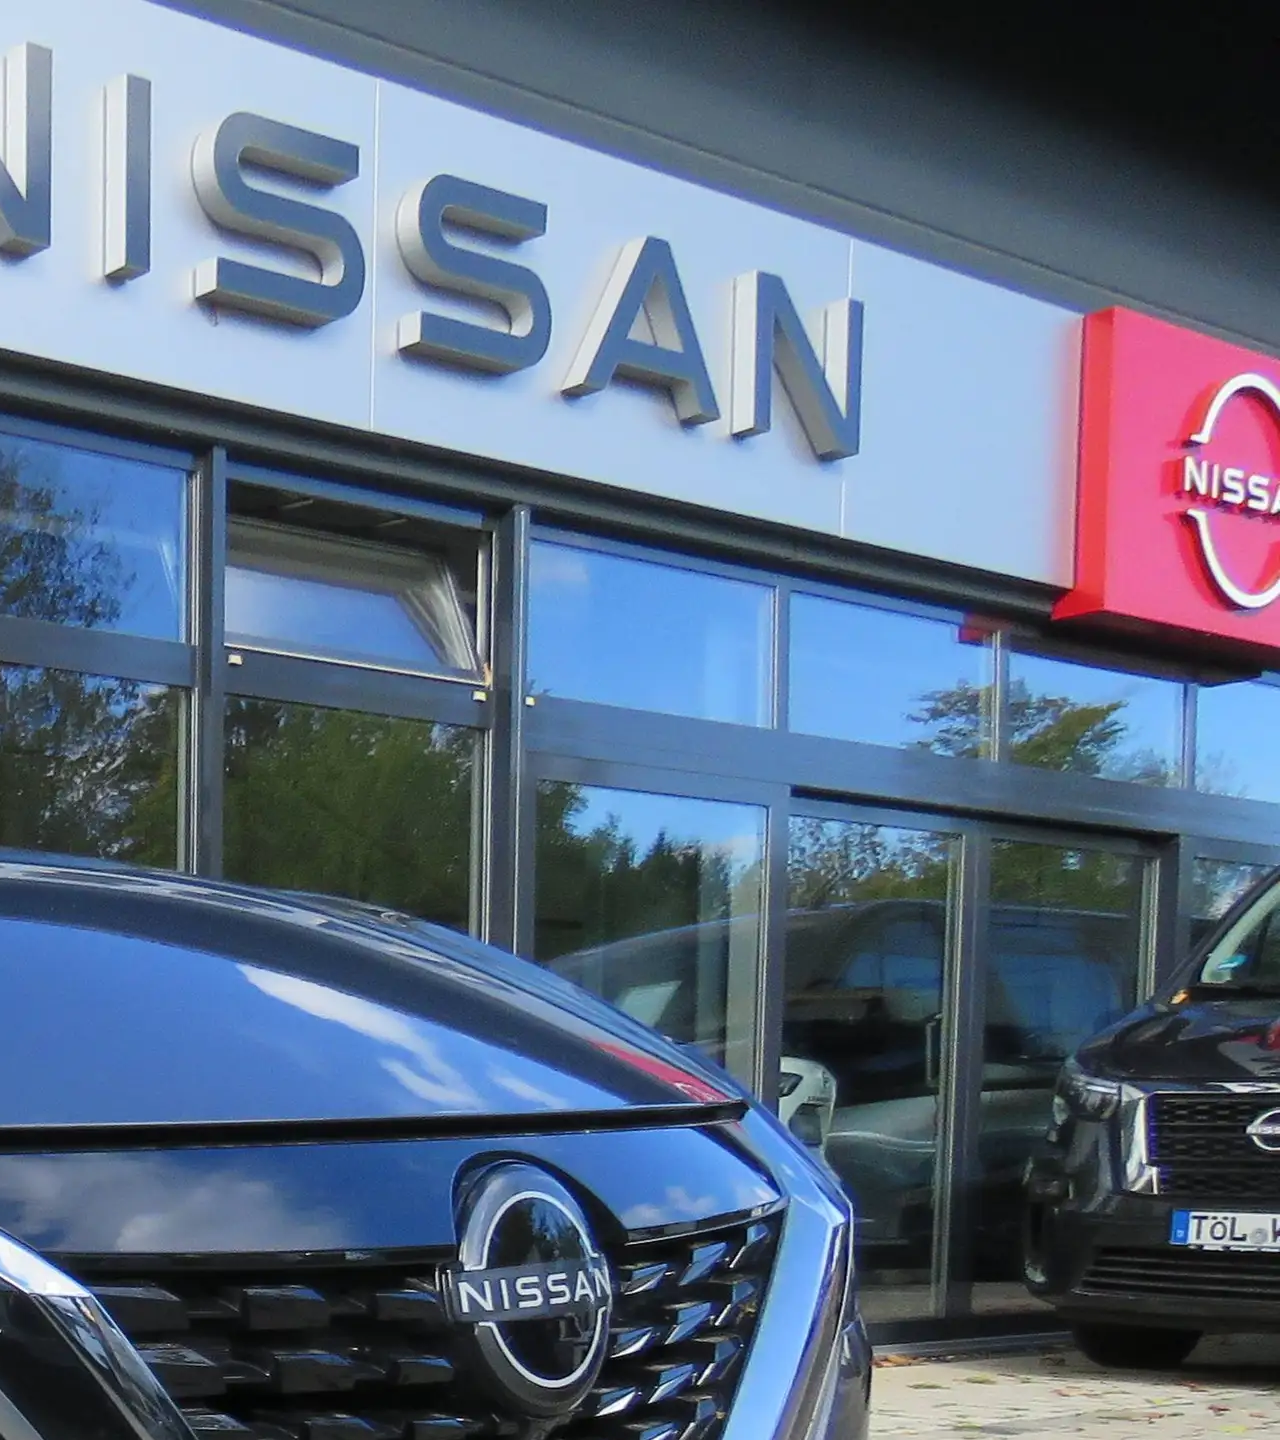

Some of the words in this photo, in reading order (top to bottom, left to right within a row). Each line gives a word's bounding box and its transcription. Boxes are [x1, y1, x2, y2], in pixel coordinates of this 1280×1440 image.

[1183, 455, 1280, 514] NISS
[1192, 1215, 1247, 1242] TÖL
[458, 1265, 612, 1313] NISSAN
